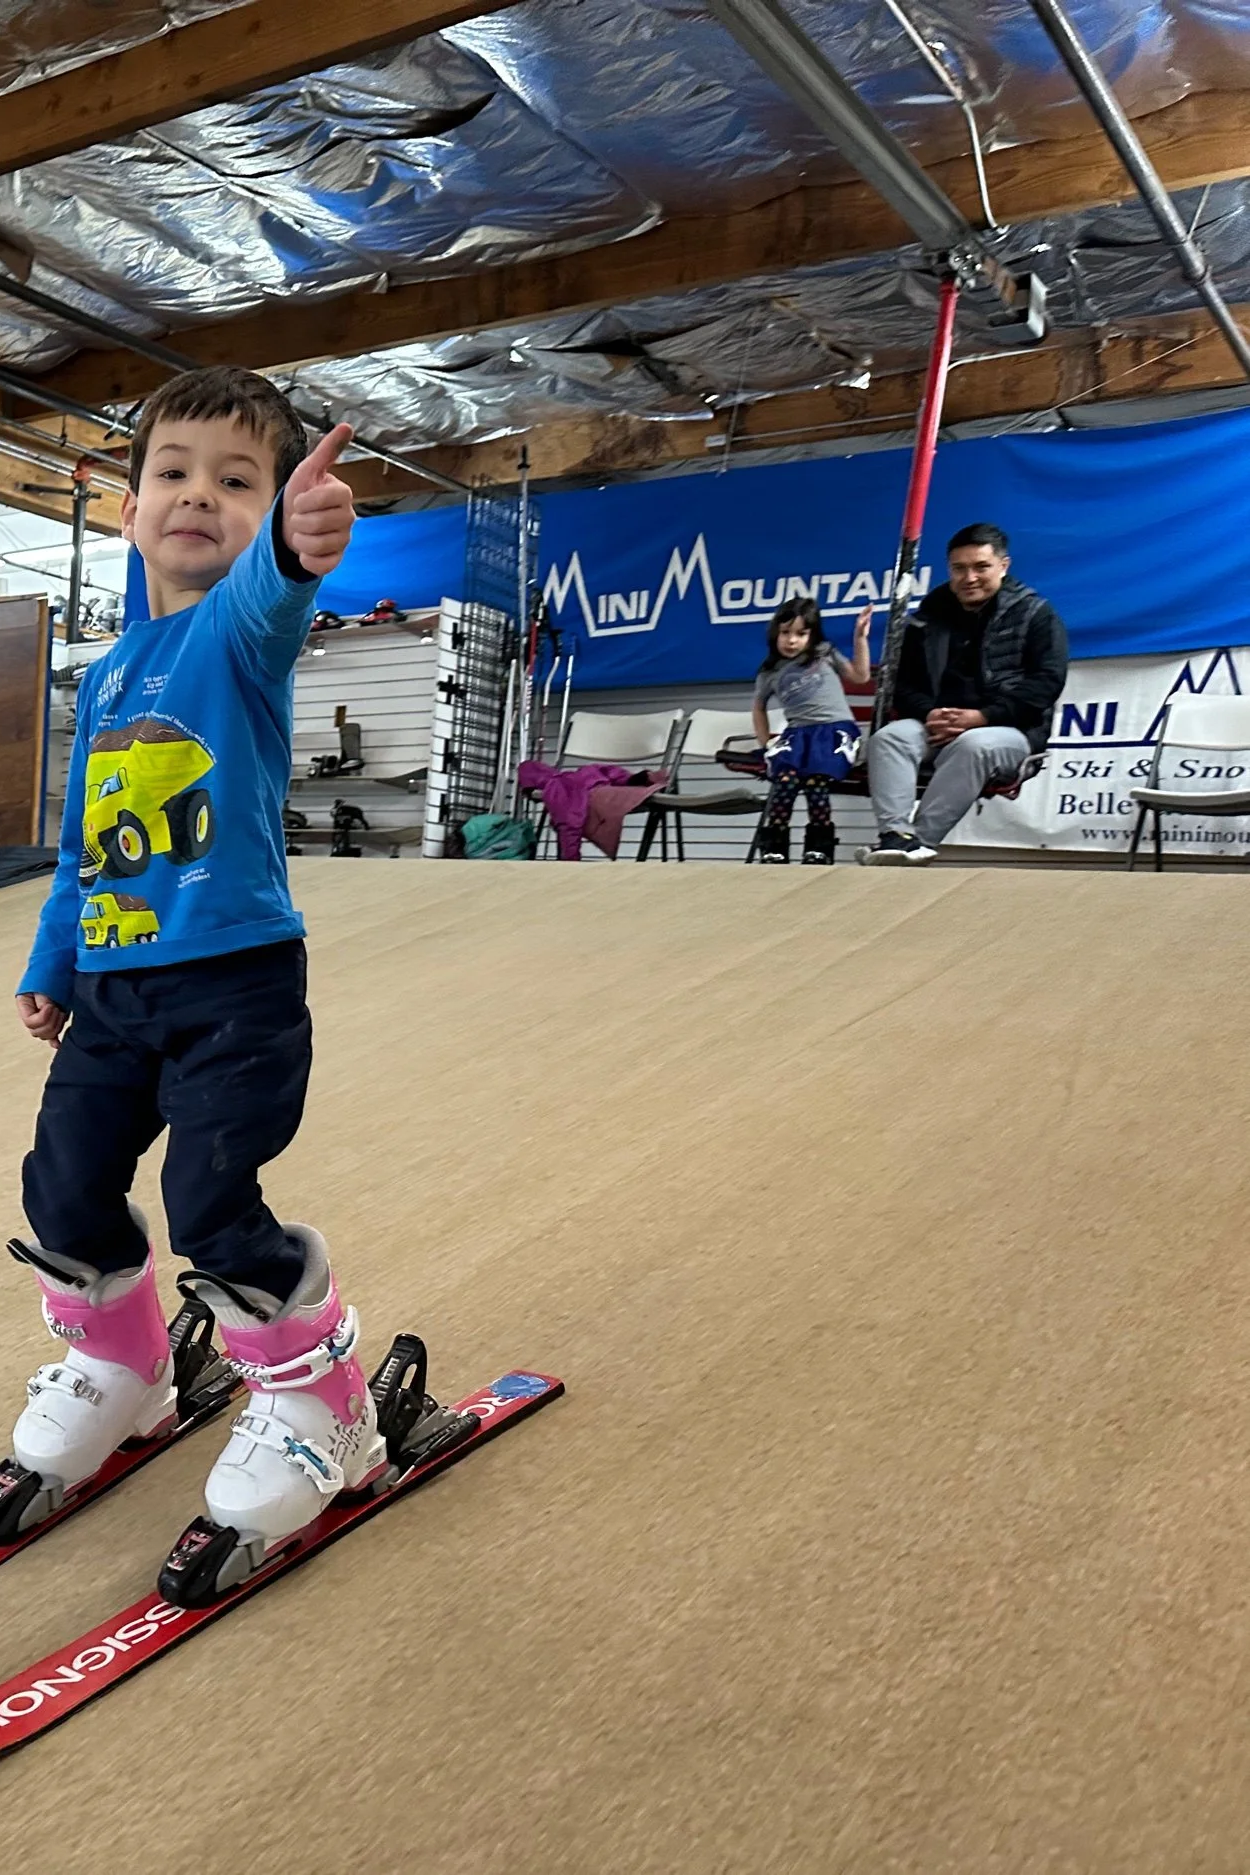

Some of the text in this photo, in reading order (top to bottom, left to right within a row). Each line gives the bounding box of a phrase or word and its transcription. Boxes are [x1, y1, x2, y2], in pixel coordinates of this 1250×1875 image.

[1057, 759, 1250, 779] Ski & Sno
[1057, 792, 1134, 815] Belle
